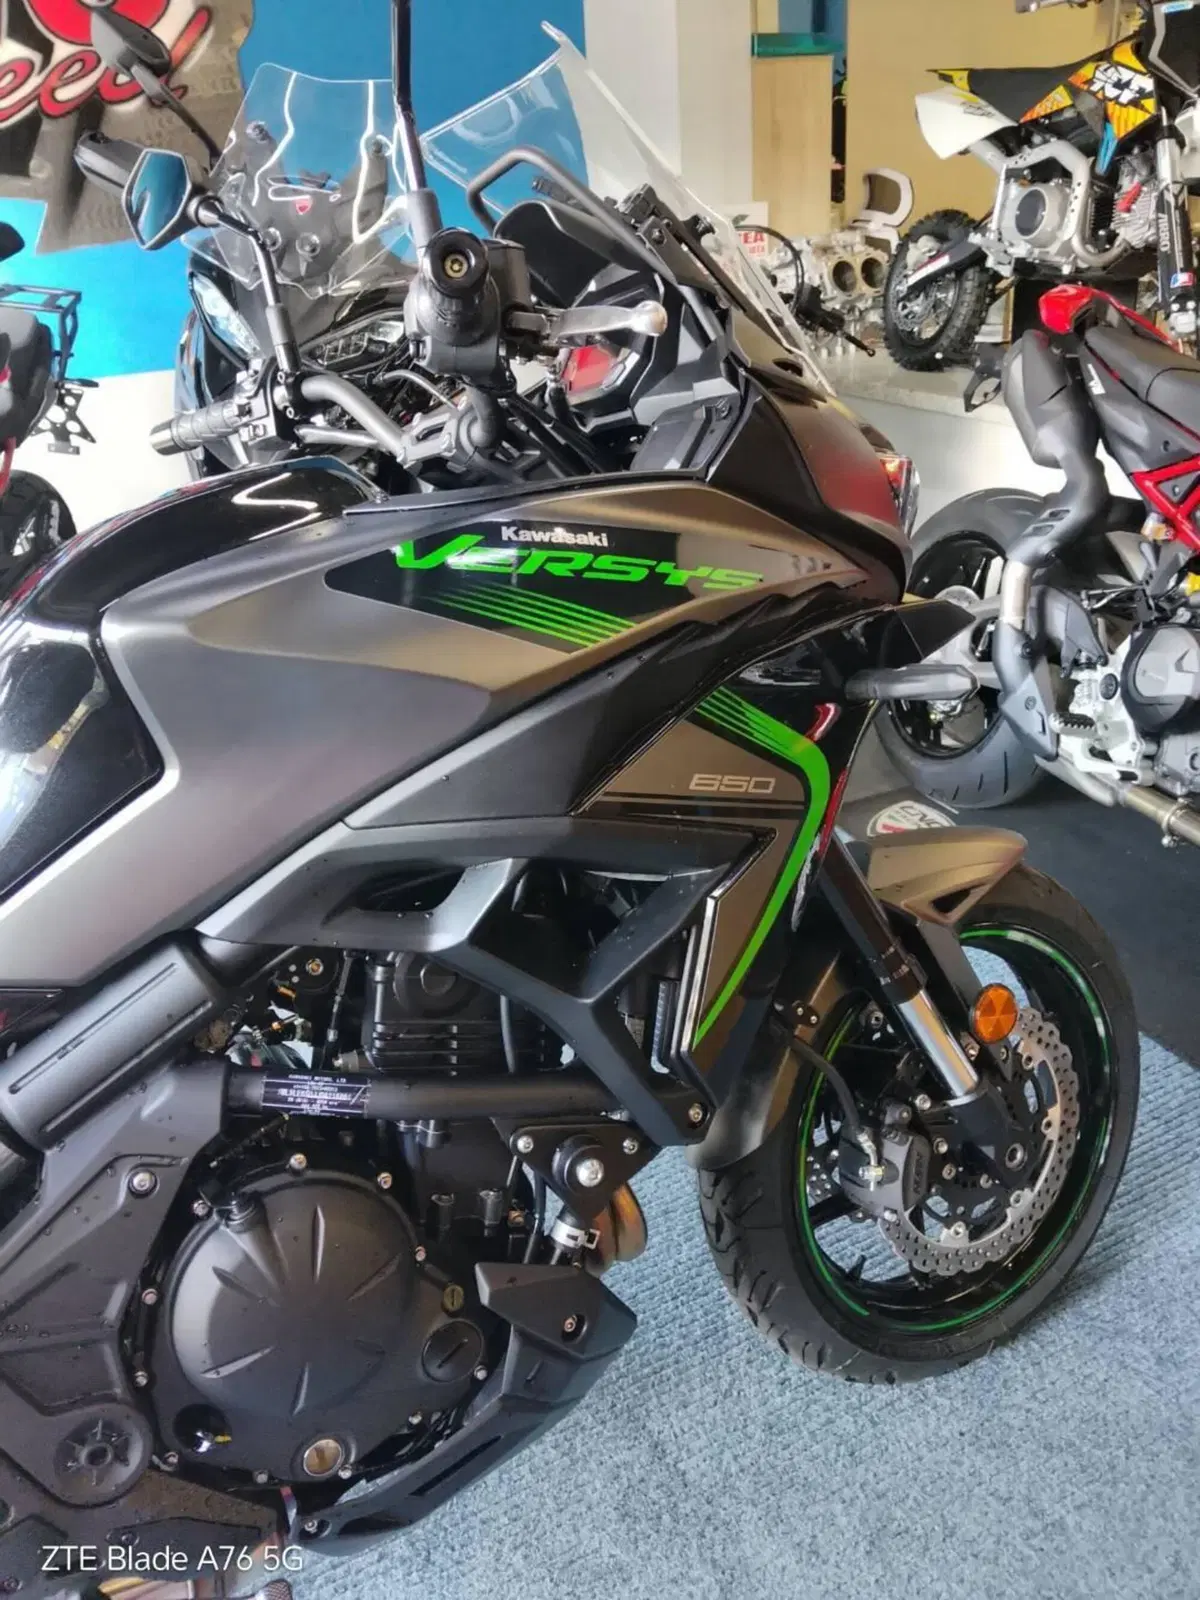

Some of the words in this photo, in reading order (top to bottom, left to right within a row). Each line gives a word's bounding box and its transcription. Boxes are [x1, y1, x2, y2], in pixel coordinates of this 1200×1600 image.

[501, 526, 608, 547] Kawasaki
[395, 534, 764, 590] VERSYS
[689, 773, 775, 794] 650
